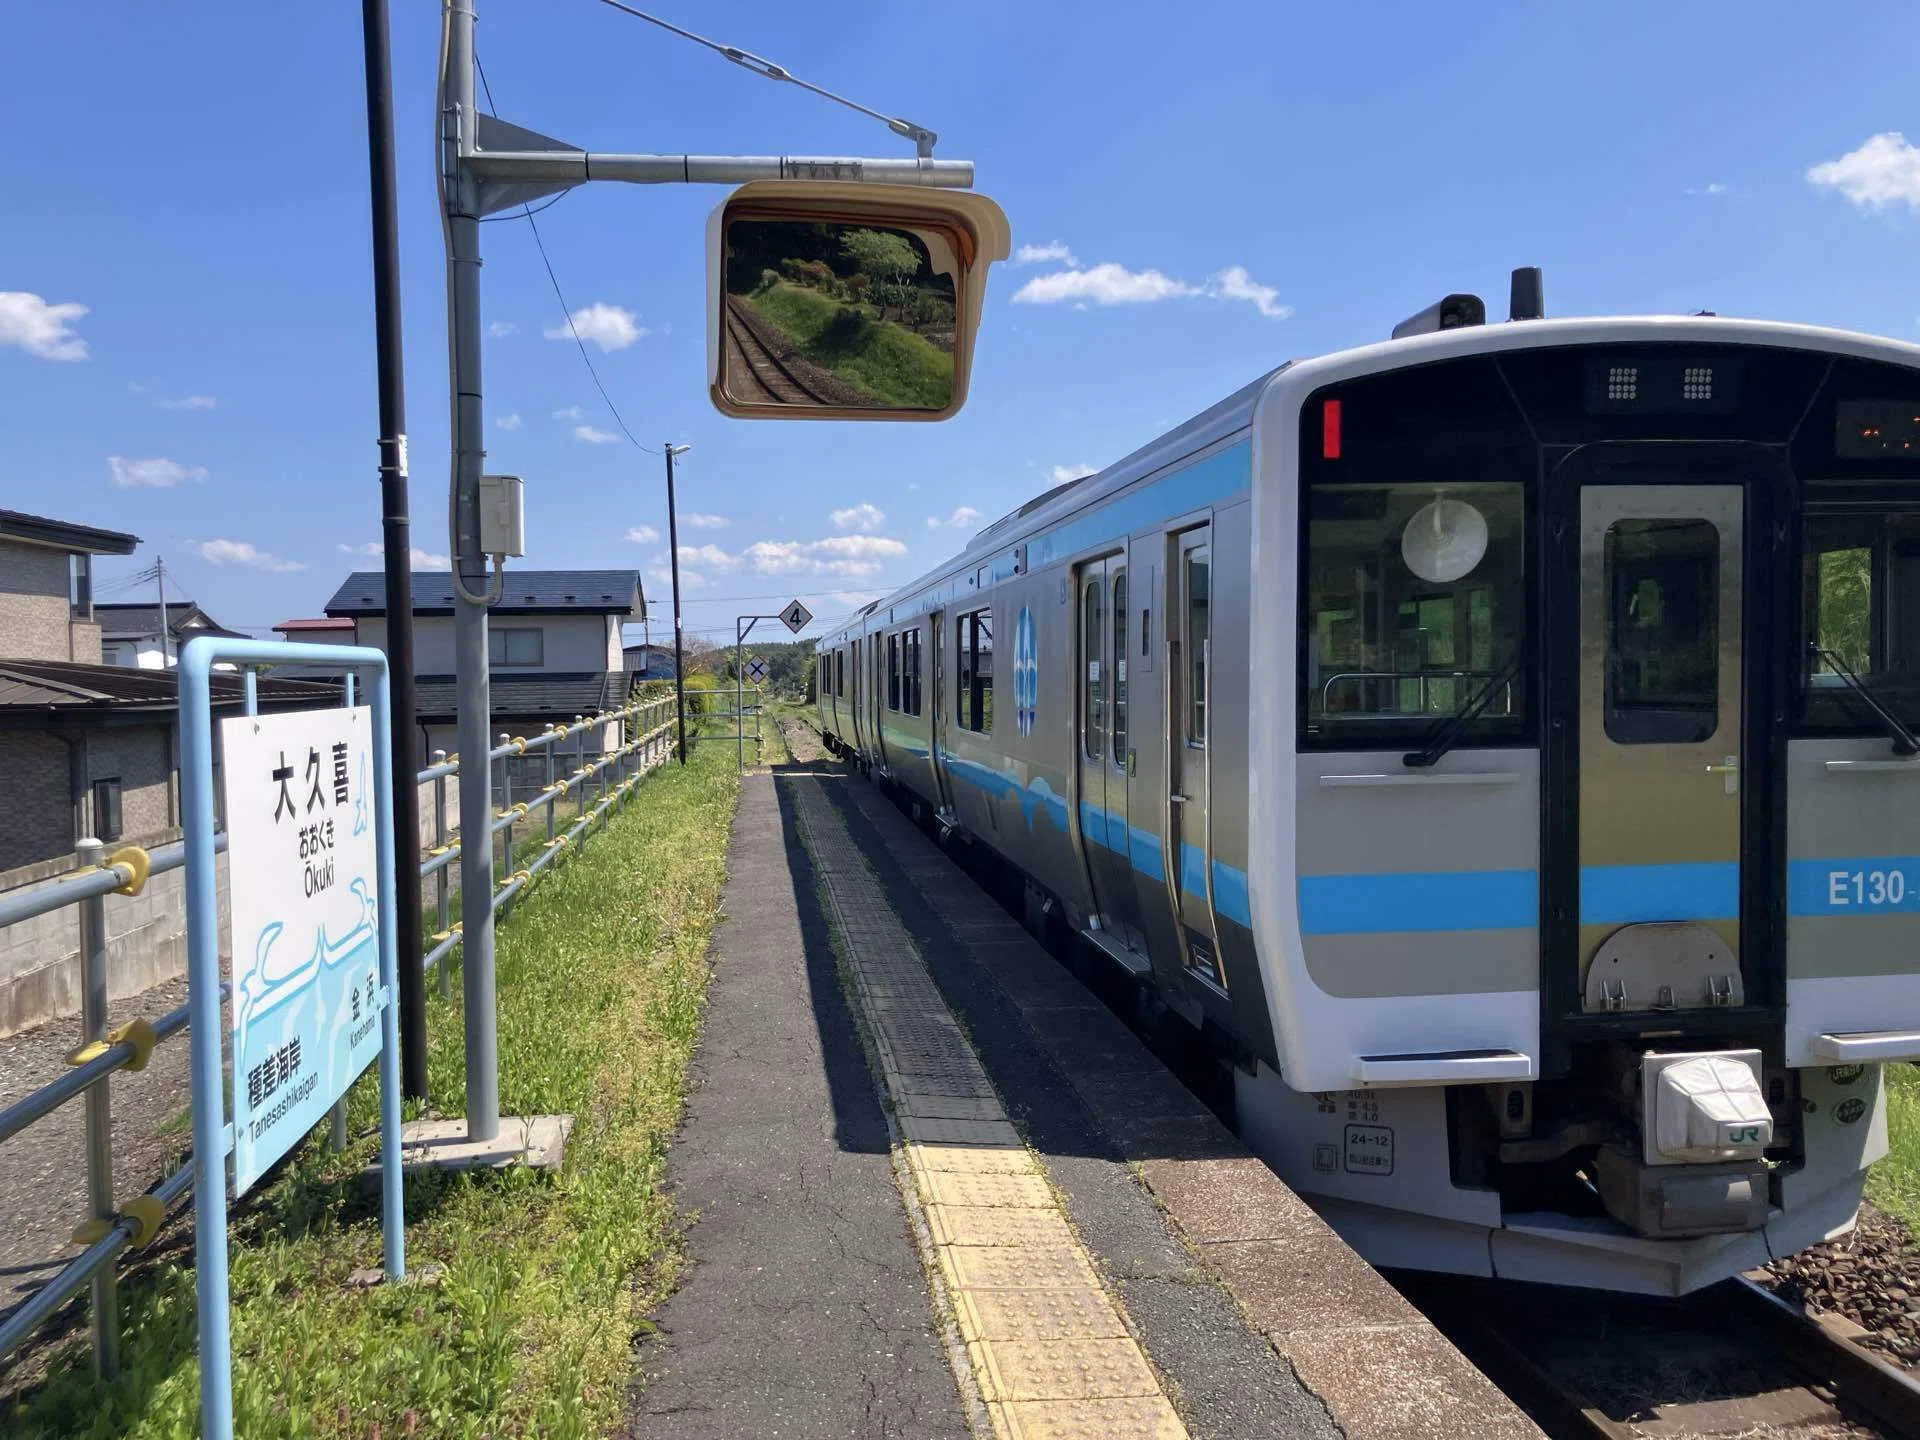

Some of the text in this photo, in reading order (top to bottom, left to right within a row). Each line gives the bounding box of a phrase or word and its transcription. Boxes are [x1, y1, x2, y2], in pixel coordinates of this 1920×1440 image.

[790, 608, 801, 625] 4
[272, 741, 349, 824] 大久喜
[299, 817, 334, 859] おおくき
[304, 856, 334, 898] Ōkuki
[1829, 870, 1919, 904] E130-
[350, 1015, 375, 1050] Kanehama
[247, 1036, 301, 1112] 種差海岸
[249, 1071, 318, 1142] Tanesashikaigan
[1351, 1133, 1388, 1146] 24-12
[1728, 1126, 1759, 1143] JR
